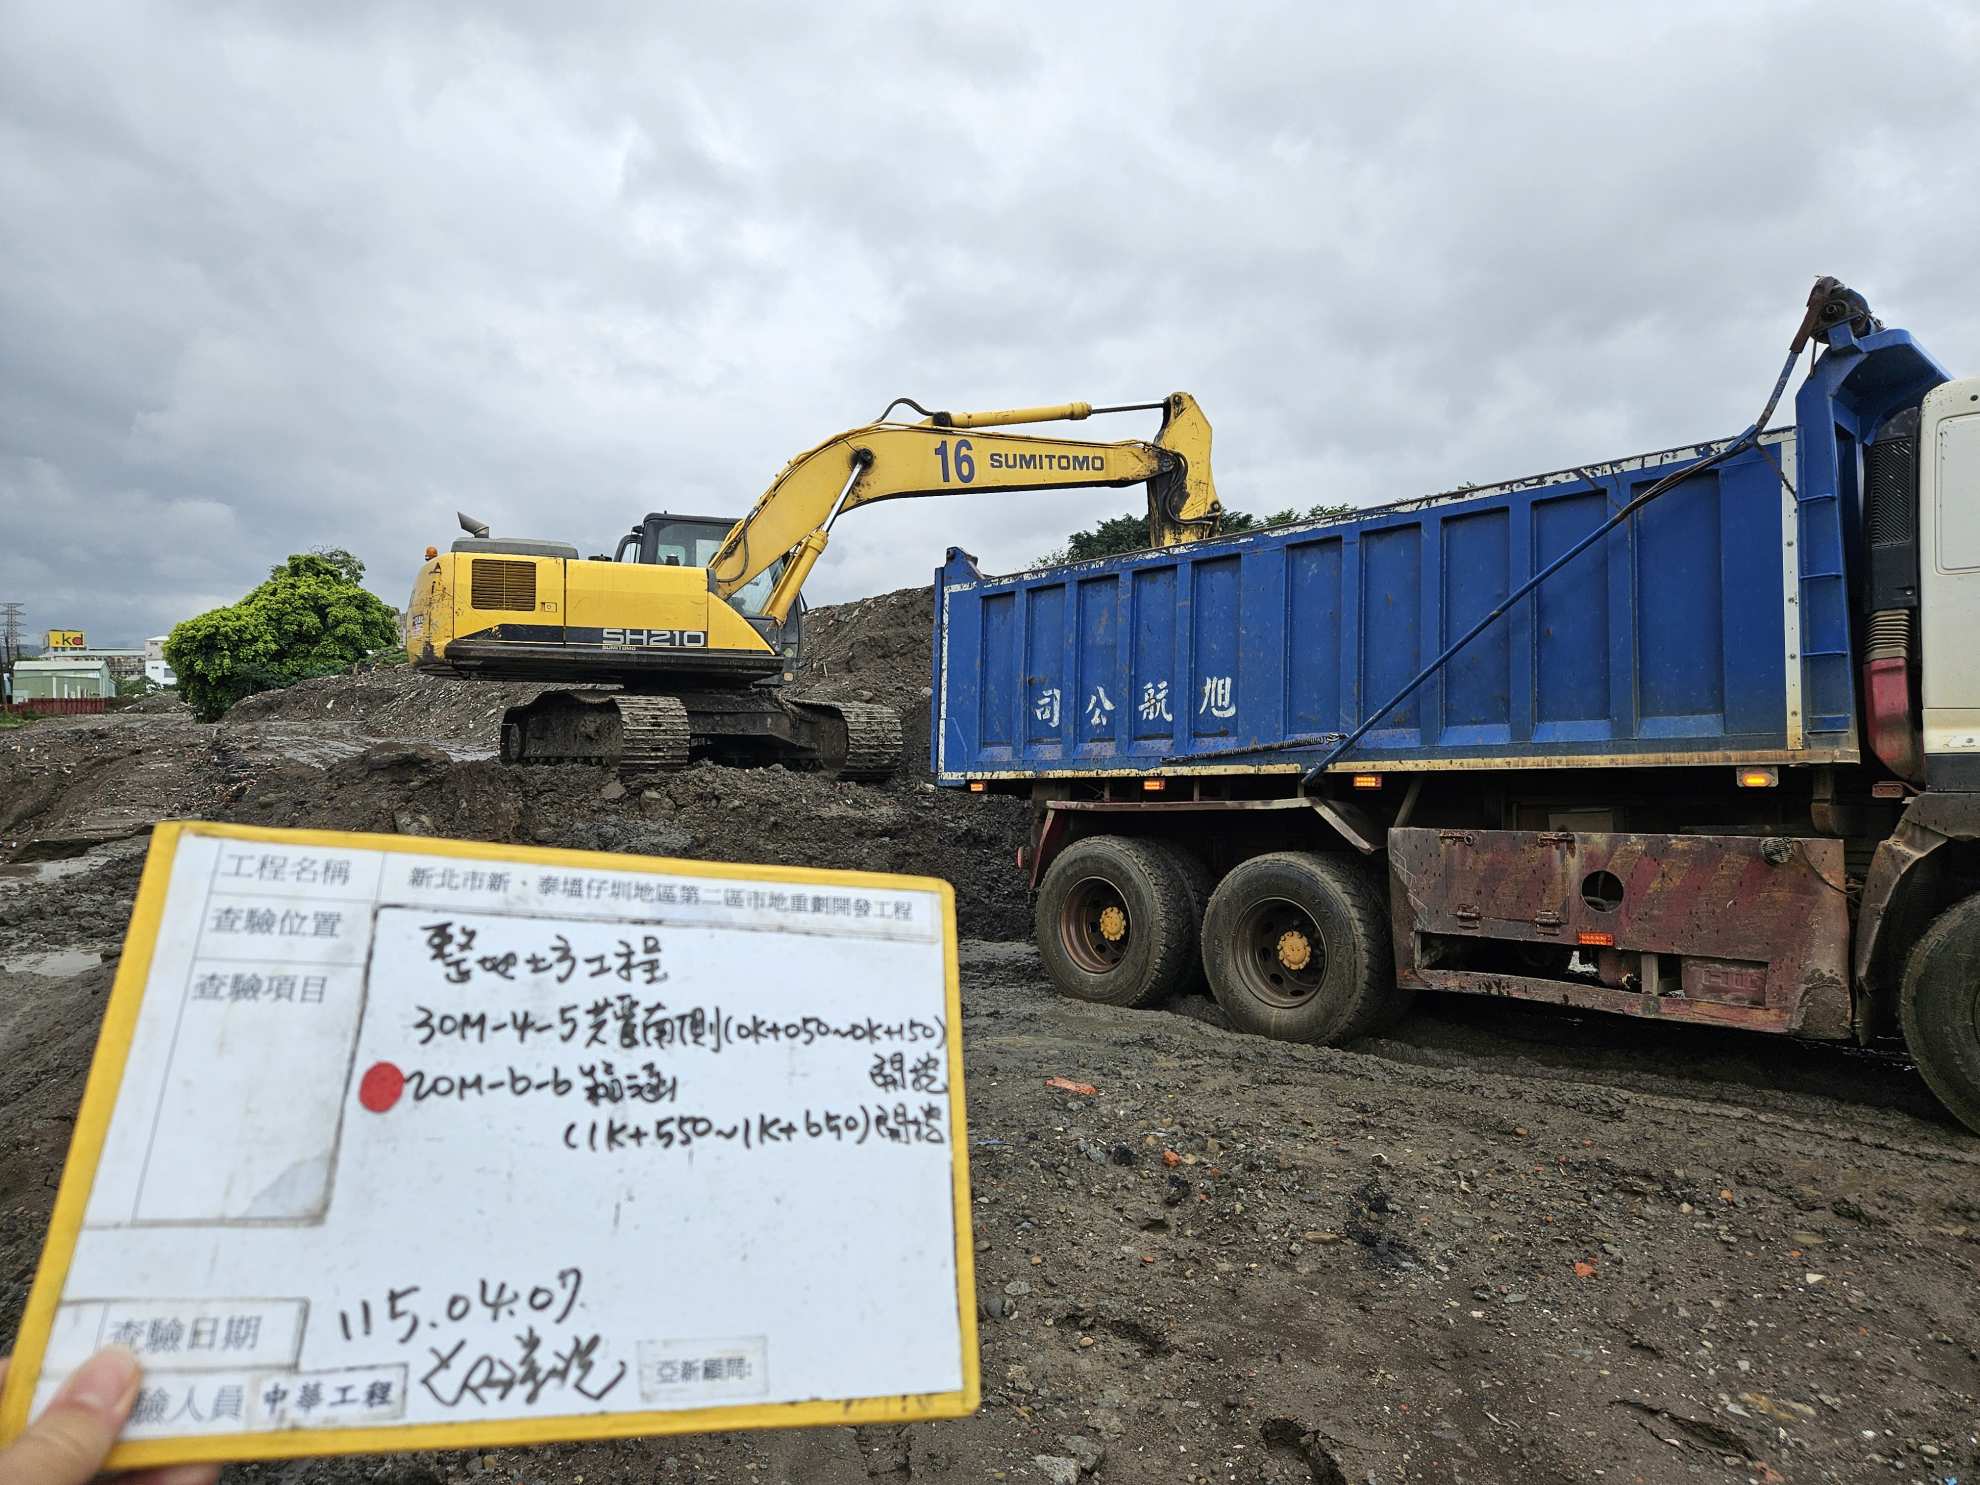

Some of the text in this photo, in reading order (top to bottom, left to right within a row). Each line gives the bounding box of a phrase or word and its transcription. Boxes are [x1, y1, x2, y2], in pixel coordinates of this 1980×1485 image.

[934, 439, 1105, 484] 16 SUMITOMO
[602, 628, 705, 647] SH210
[220, 853, 352, 886] 工程名稱
[209, 905, 342, 939] 查驗位置
[191, 971, 328, 1004] 查驗項目
[340, 1267, 582, 1343] 115.04.07
[109, 1314, 263, 1355] 查驗日期
[128, 1383, 245, 1426] 驗人員
[261, 1379, 396, 1417] 中華工程
